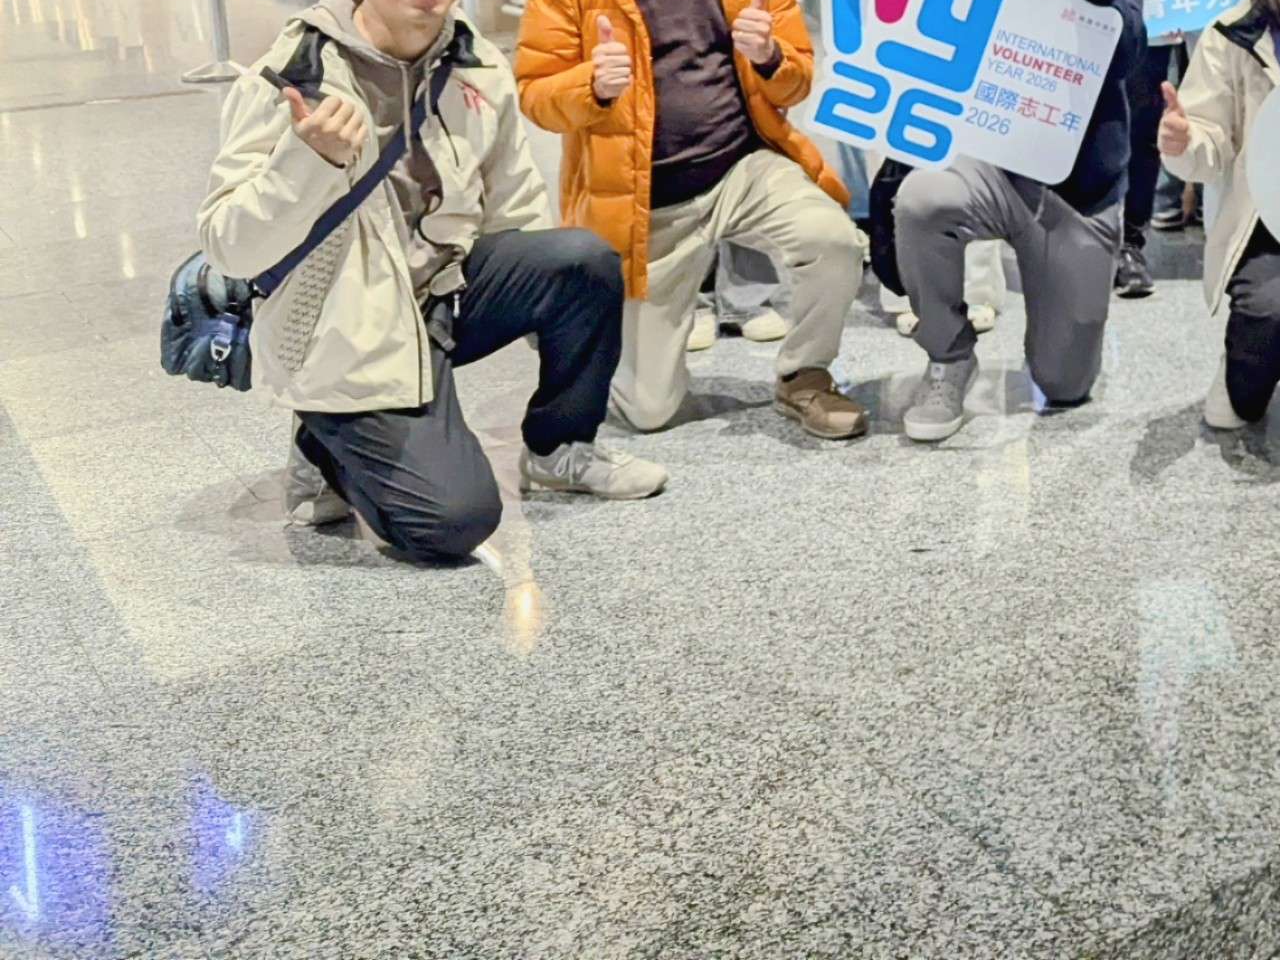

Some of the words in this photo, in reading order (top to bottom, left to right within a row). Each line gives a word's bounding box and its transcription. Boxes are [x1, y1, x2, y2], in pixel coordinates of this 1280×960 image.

[987, 58, 1025, 81] YEAR
[1025, 72, 1058, 93] 2026
[992, 43, 1085, 86] VOLUNTEER
[996, 29, 1102, 77] INTERNATIONAL
[814, 60, 964, 163] 26
[965, 107, 1012, 136] 2026
[974, 80, 1083, 132] 國際志工年
